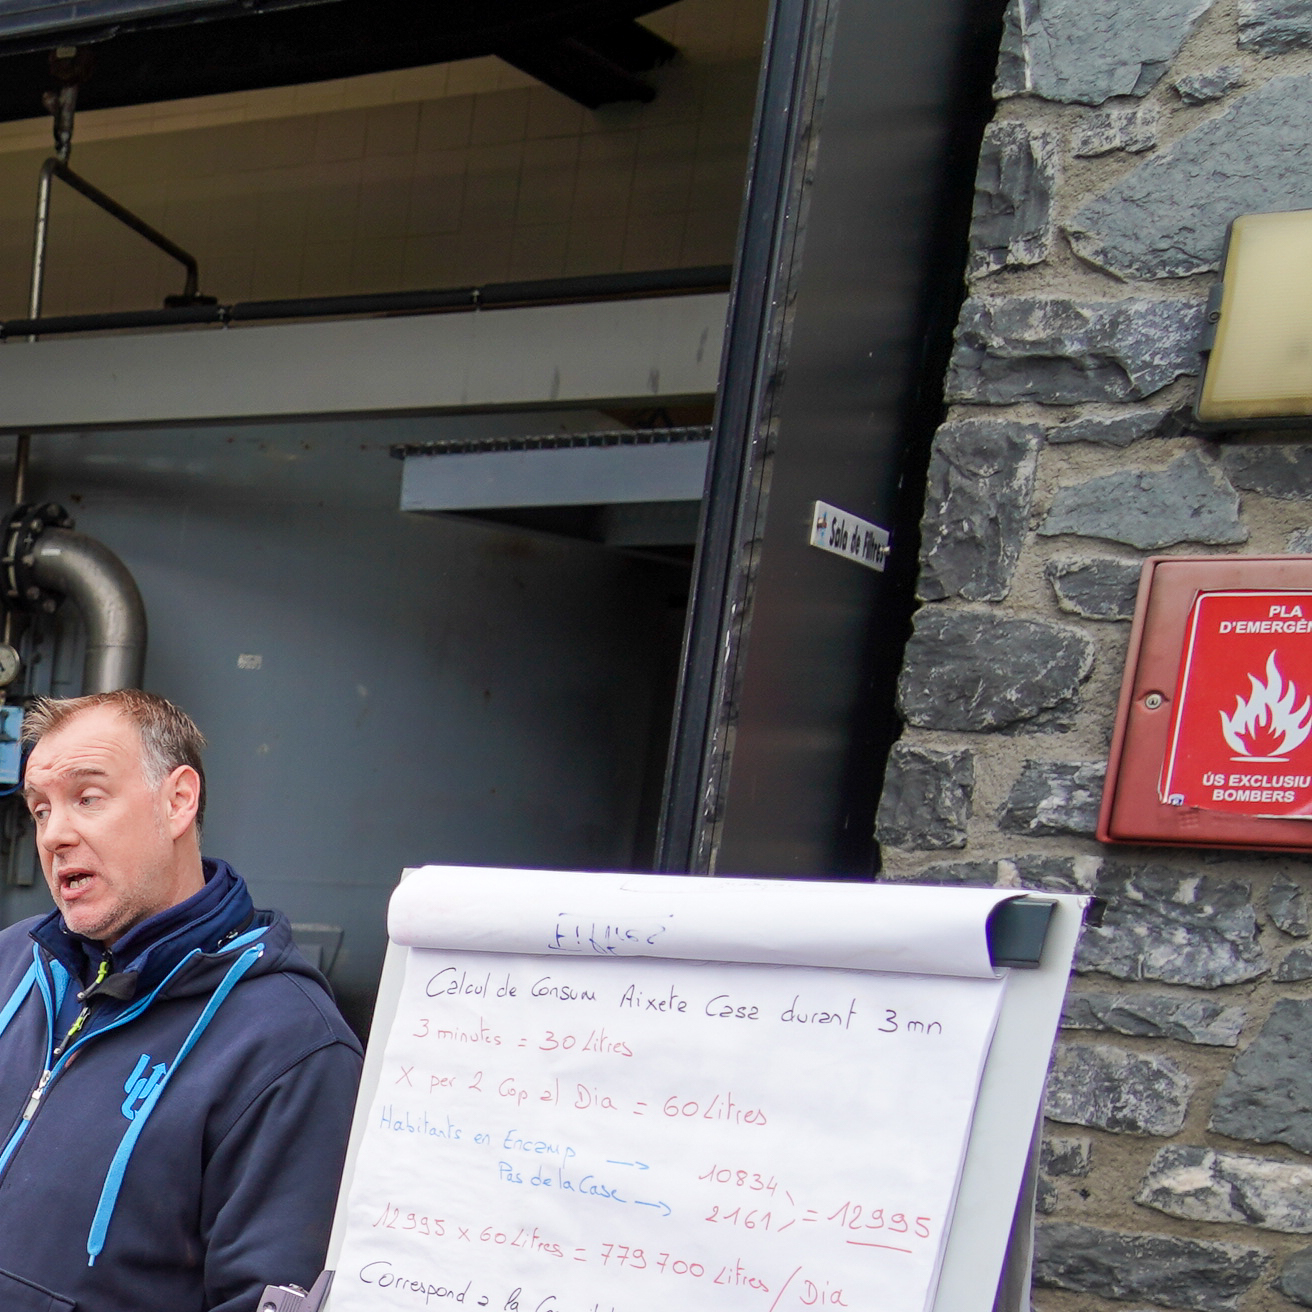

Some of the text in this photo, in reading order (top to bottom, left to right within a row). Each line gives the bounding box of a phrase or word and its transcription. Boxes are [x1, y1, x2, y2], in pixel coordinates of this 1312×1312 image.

[829, 516, 848, 551] Sala
[851, 524, 861, 556] de
[1268, 605, 1303, 618] PLA
[1202, 771, 1311, 788] ÚS EXCLUSIU
[1212, 789, 1295, 803] BOMBERS
[426, 967, 491, 998] Calcul
[496, 973, 517, 998] de
[705, 995, 759, 1020] Casa
[780, 995, 857, 1030] durant
[877, 1009, 898, 1033] 3
[907, 1021, 942, 1035] mn
[412, 1019, 430, 1038] 3
[437, 1016, 502, 1046] minutes
[539, 1031, 576, 1051] 30
[429, 1075, 457, 1094] per
[468, 1071, 483, 1092] 2
[498, 1077, 528, 1107] Cop
[540, 1077, 559, 1106] al
[574, 1083, 618, 1110] Dia
[380, 1104, 778, 1197] Habitants en Encamp 10834
[498, 1161, 523, 1184] Pas
[530, 1165, 552, 1187] de
[558, 1167, 575, 1191] la
[705, 1205, 771, 1231] 2161
[827, 1201, 931, 1239] 12995
[373, 1202, 446, 1236] 12995
[799, 1279, 848, 1307] Dia
[359, 1261, 472, 1305] Correspond
